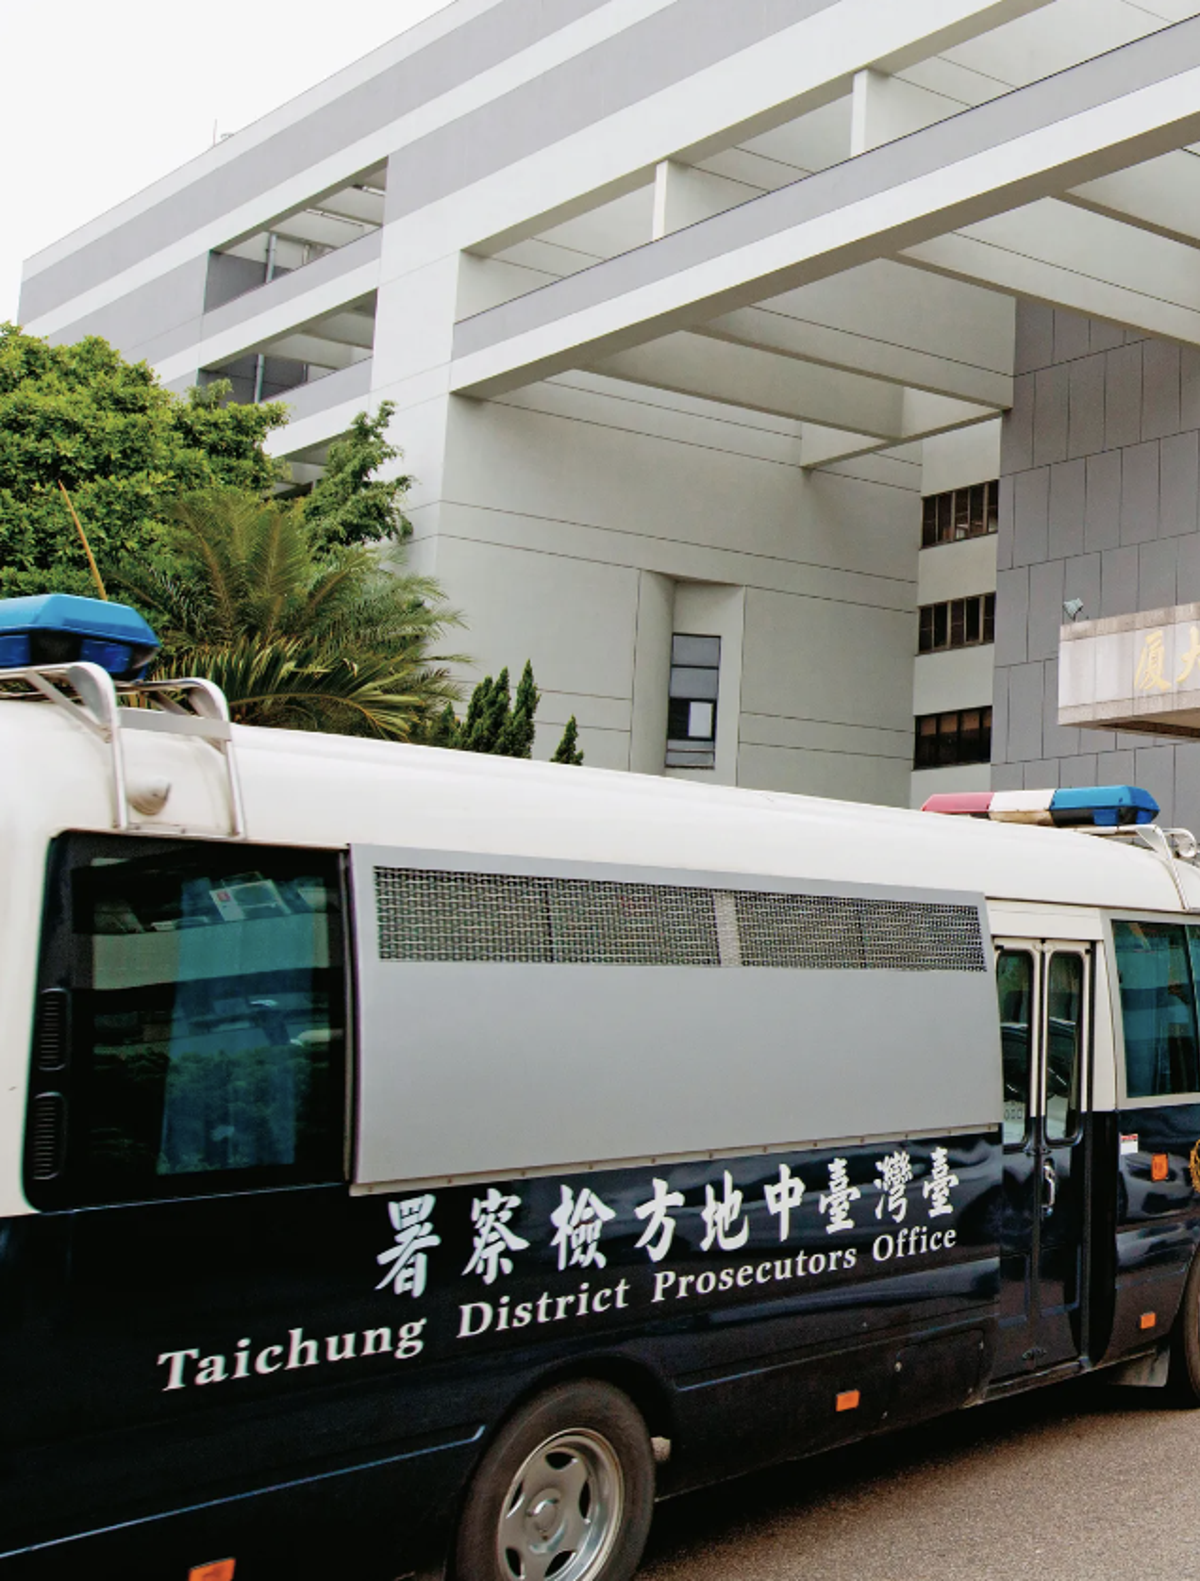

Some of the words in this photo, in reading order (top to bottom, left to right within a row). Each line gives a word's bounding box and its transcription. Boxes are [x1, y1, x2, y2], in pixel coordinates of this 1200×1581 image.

[157, 1316, 427, 1391] Taichung
[456, 1276, 631, 1339] District
[650, 1245, 858, 1303] Prosecutors
[872, 1225, 958, 1262] Office
